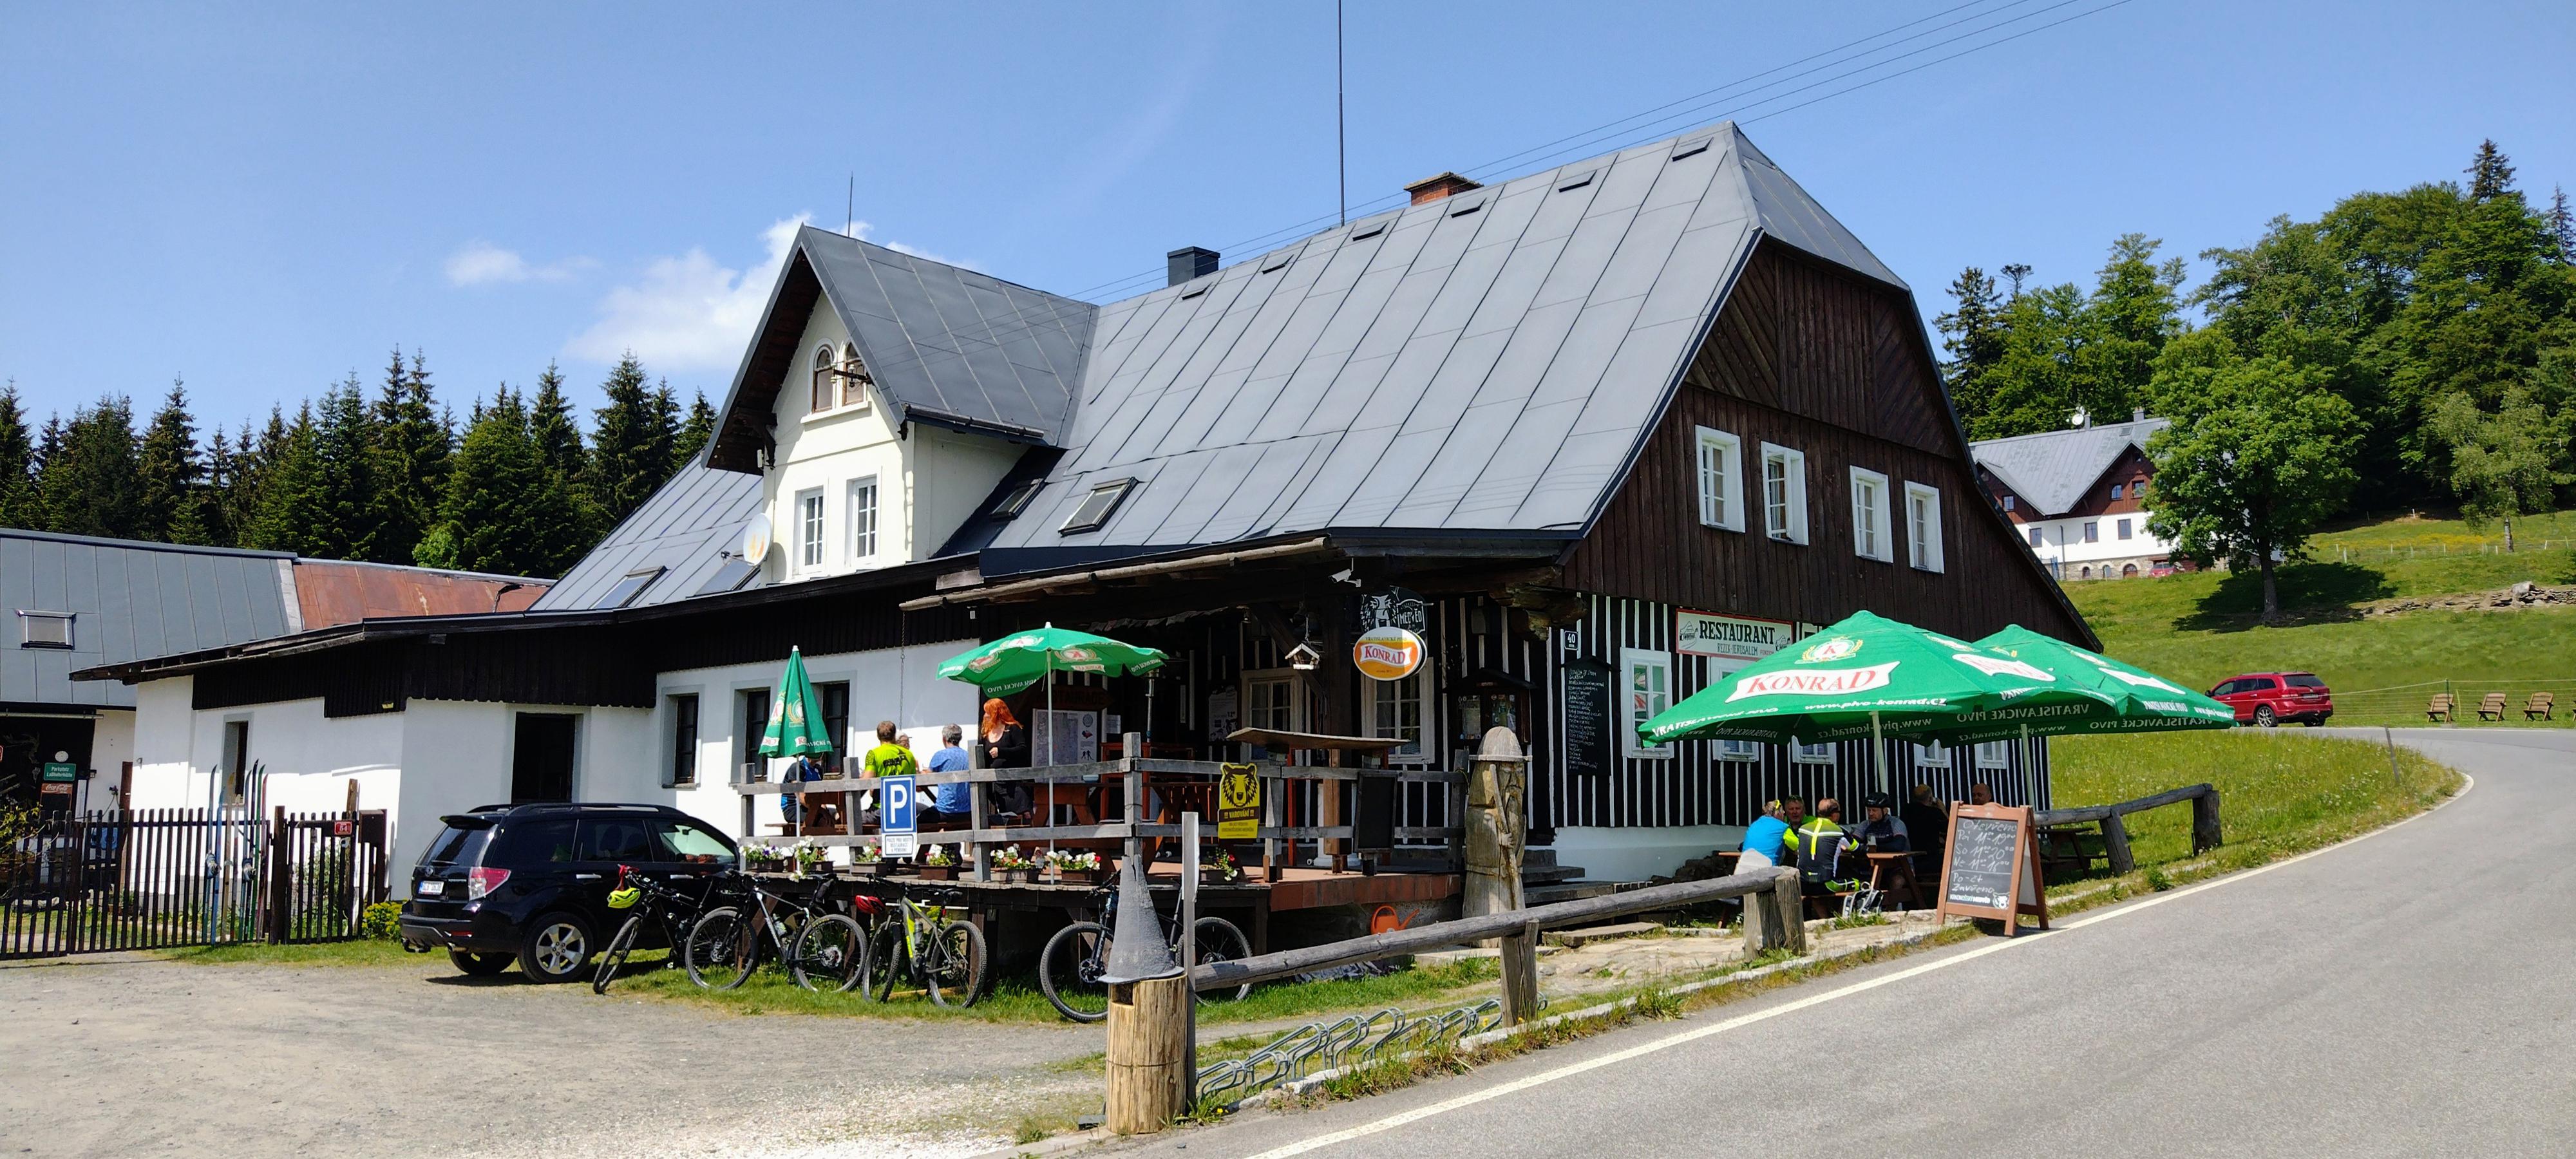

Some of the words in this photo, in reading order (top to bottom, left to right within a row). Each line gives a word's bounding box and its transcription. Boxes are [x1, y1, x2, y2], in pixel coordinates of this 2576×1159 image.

[1567, 633, 1575, 643] 40
[1699, 620, 1776, 645] RESTAURANT
[1365, 646, 1406, 664] KONRAD
[1747, 670, 1876, 693] KONRAD
[890, 784, 907, 824] P
